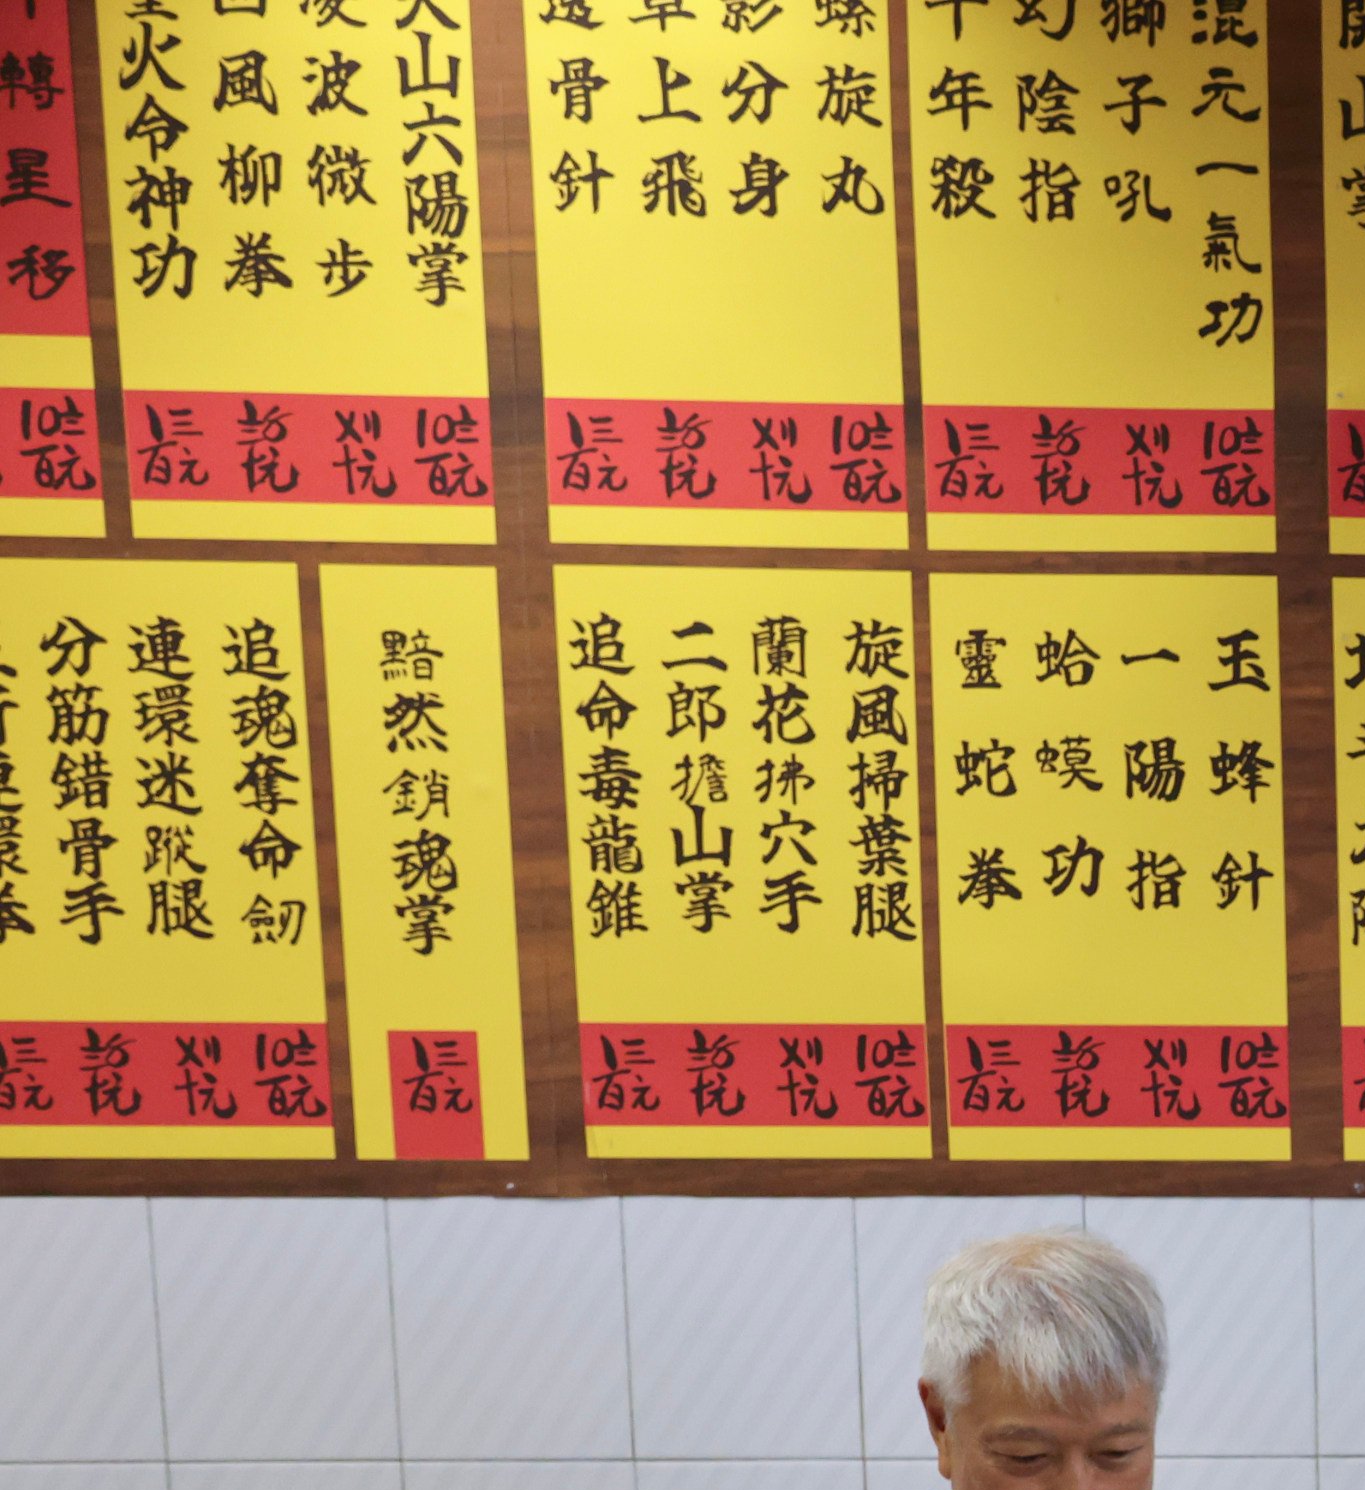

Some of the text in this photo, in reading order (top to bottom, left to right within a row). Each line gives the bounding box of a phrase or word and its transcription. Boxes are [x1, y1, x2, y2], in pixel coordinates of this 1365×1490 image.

[0, 0, 78, 302] 轉星移
[214, 0, 292, 297] 風柳拳
[40, 617, 124, 945] 分筋錯骨手
[564, 613, 648, 947] 追命毒龍錐
[845, 611, 919, 941] 旋風掃葉腿
[955, 630, 1022, 909] 靈蛇拳
[1036, 629, 1104, 896] 蛤蟆功
[1121, 649, 1186, 910] 一陽指
[1209, 629, 1274, 910] 玉蜂針
